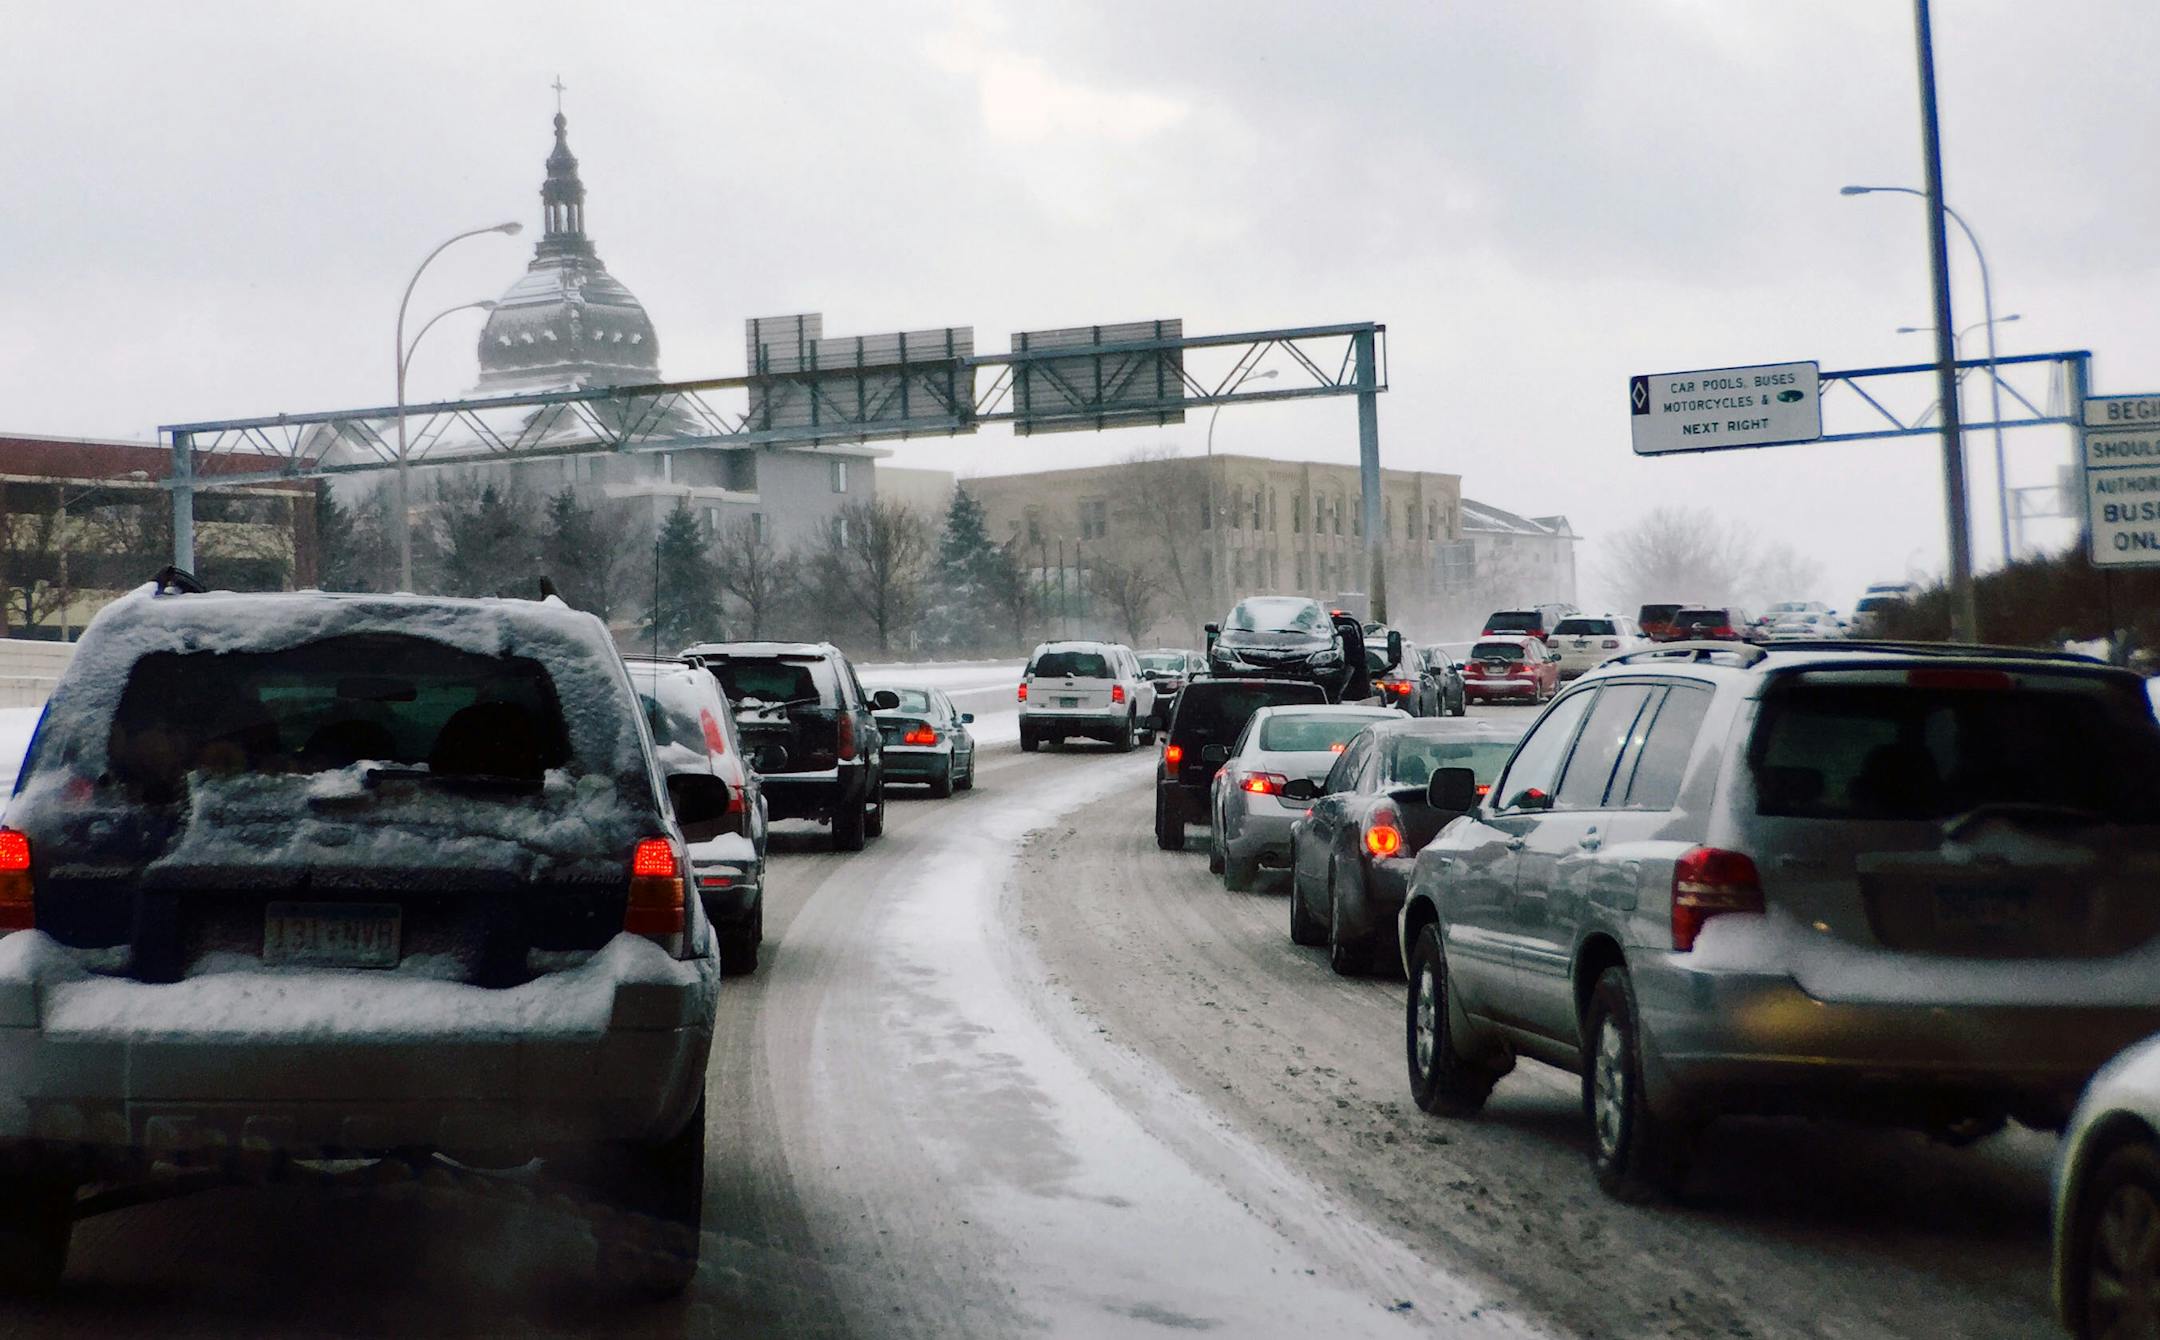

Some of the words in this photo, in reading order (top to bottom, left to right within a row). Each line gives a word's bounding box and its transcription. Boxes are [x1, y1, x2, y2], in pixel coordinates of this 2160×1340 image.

[1671, 381, 1695, 394] CAR
[1755, 373, 1796, 387] BUSES
[1664, 395, 1754, 413] MOTORCYCLES
[2107, 400, 2160, 420] BEGI
[1683, 422, 1719, 435] NEXT
[1727, 418, 1769, 432] RIGHT
[2096, 476, 2160, 494] AUTHOR
[2104, 501, 2160, 522] BUS
